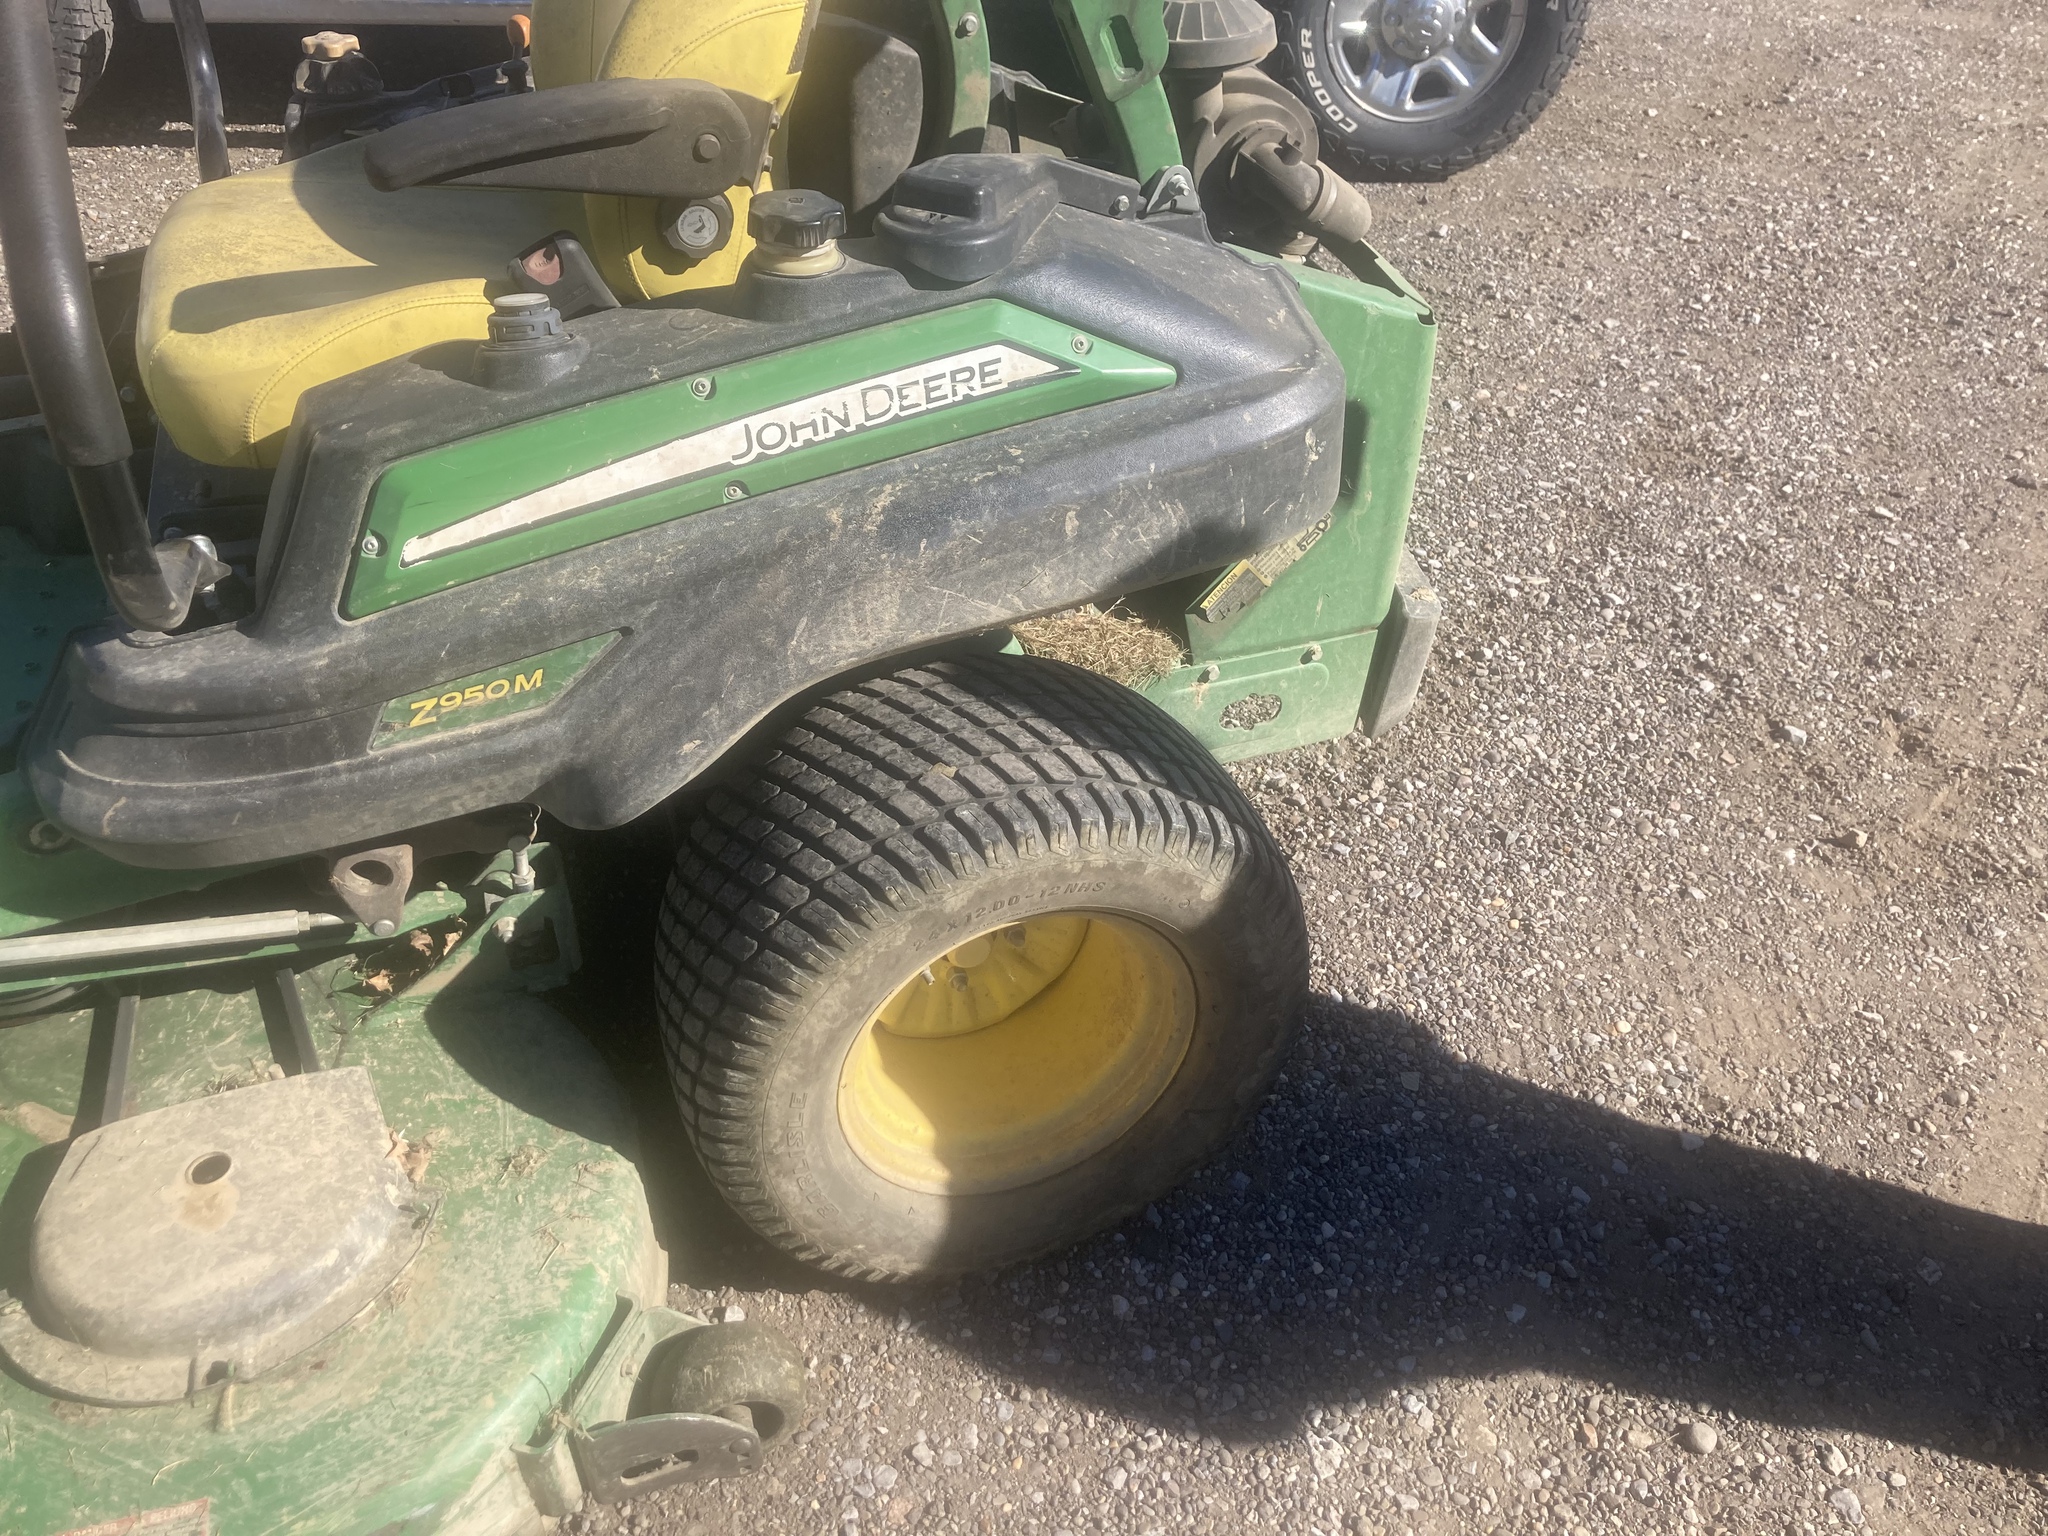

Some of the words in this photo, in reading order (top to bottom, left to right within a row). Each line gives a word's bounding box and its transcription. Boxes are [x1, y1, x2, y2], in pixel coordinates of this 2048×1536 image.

[1300, 27, 1359, 134] COOPER
[731, 400, 852, 462] JOHN
[861, 357, 1003, 420] DEERE
[1207, 572, 1239, 606] ATENCION
[409, 668, 544, 729] Z950M
[1062, 881, 1107, 895] NHS
[787, 1092, 840, 1219] CARLISLE
